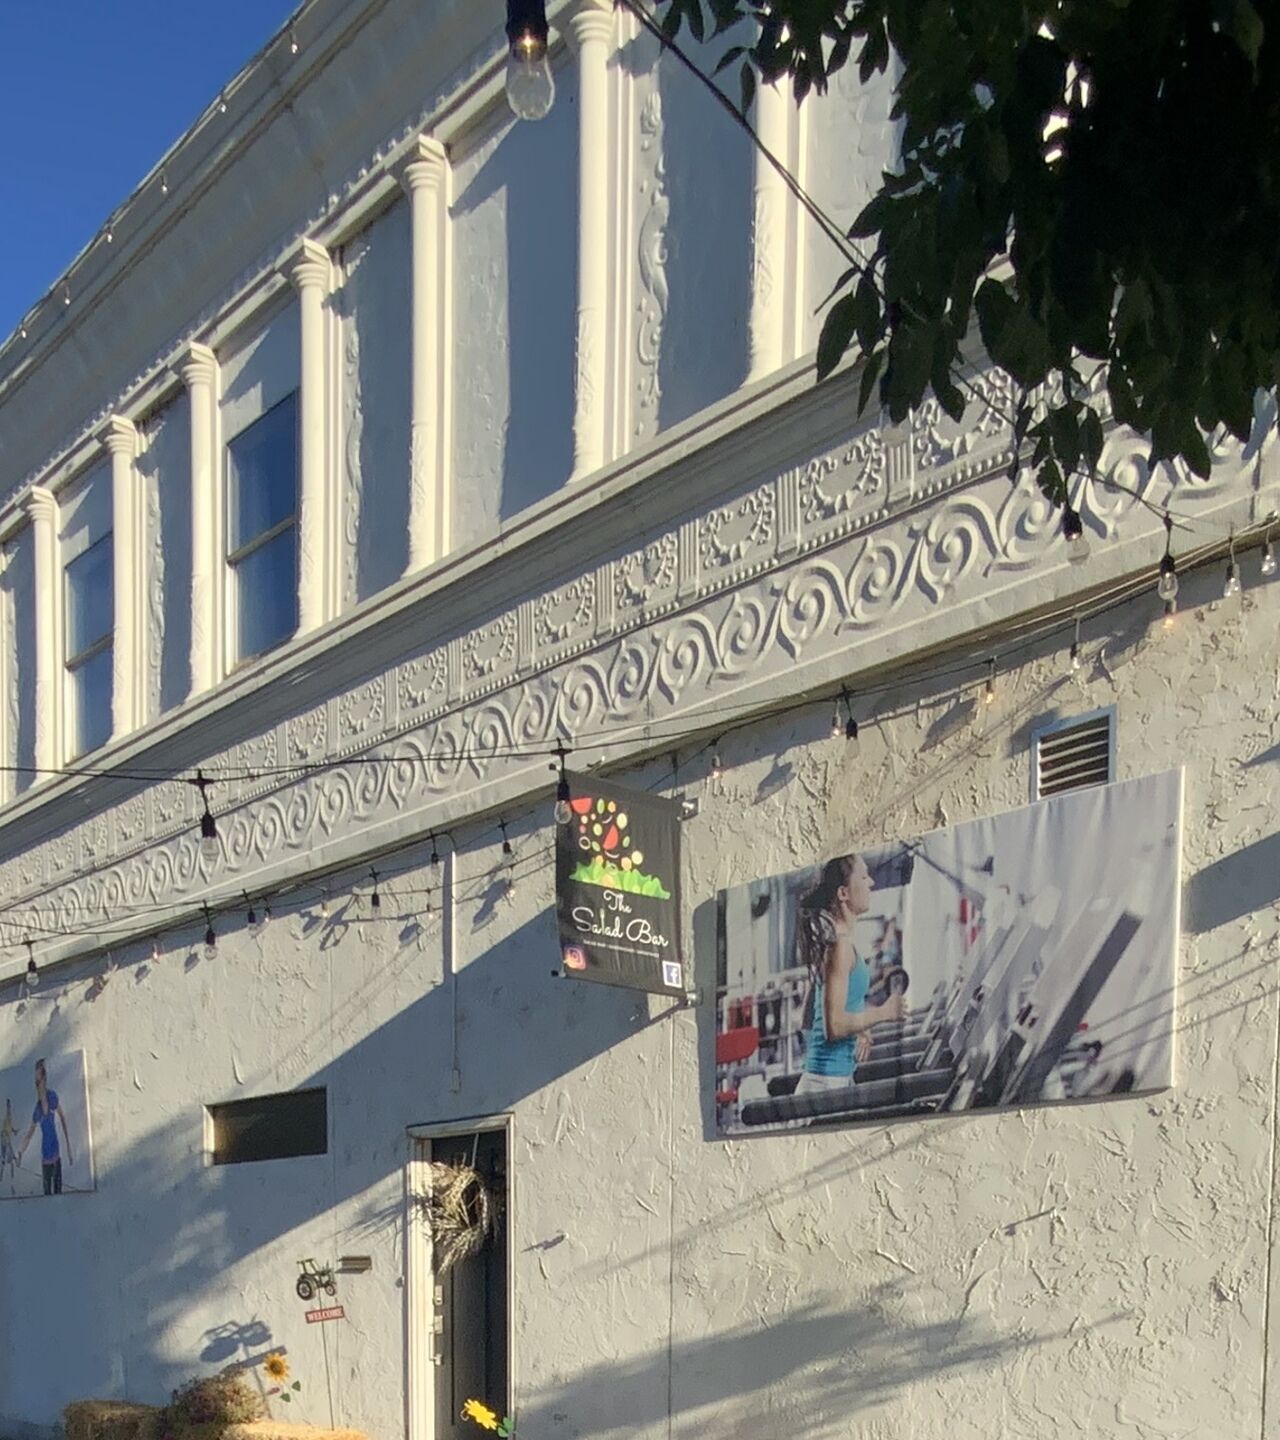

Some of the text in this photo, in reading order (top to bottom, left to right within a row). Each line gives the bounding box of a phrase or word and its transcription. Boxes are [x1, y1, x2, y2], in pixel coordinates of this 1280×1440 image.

[603, 889, 632, 914] The
[572, 906, 669, 947] Salad Bar
